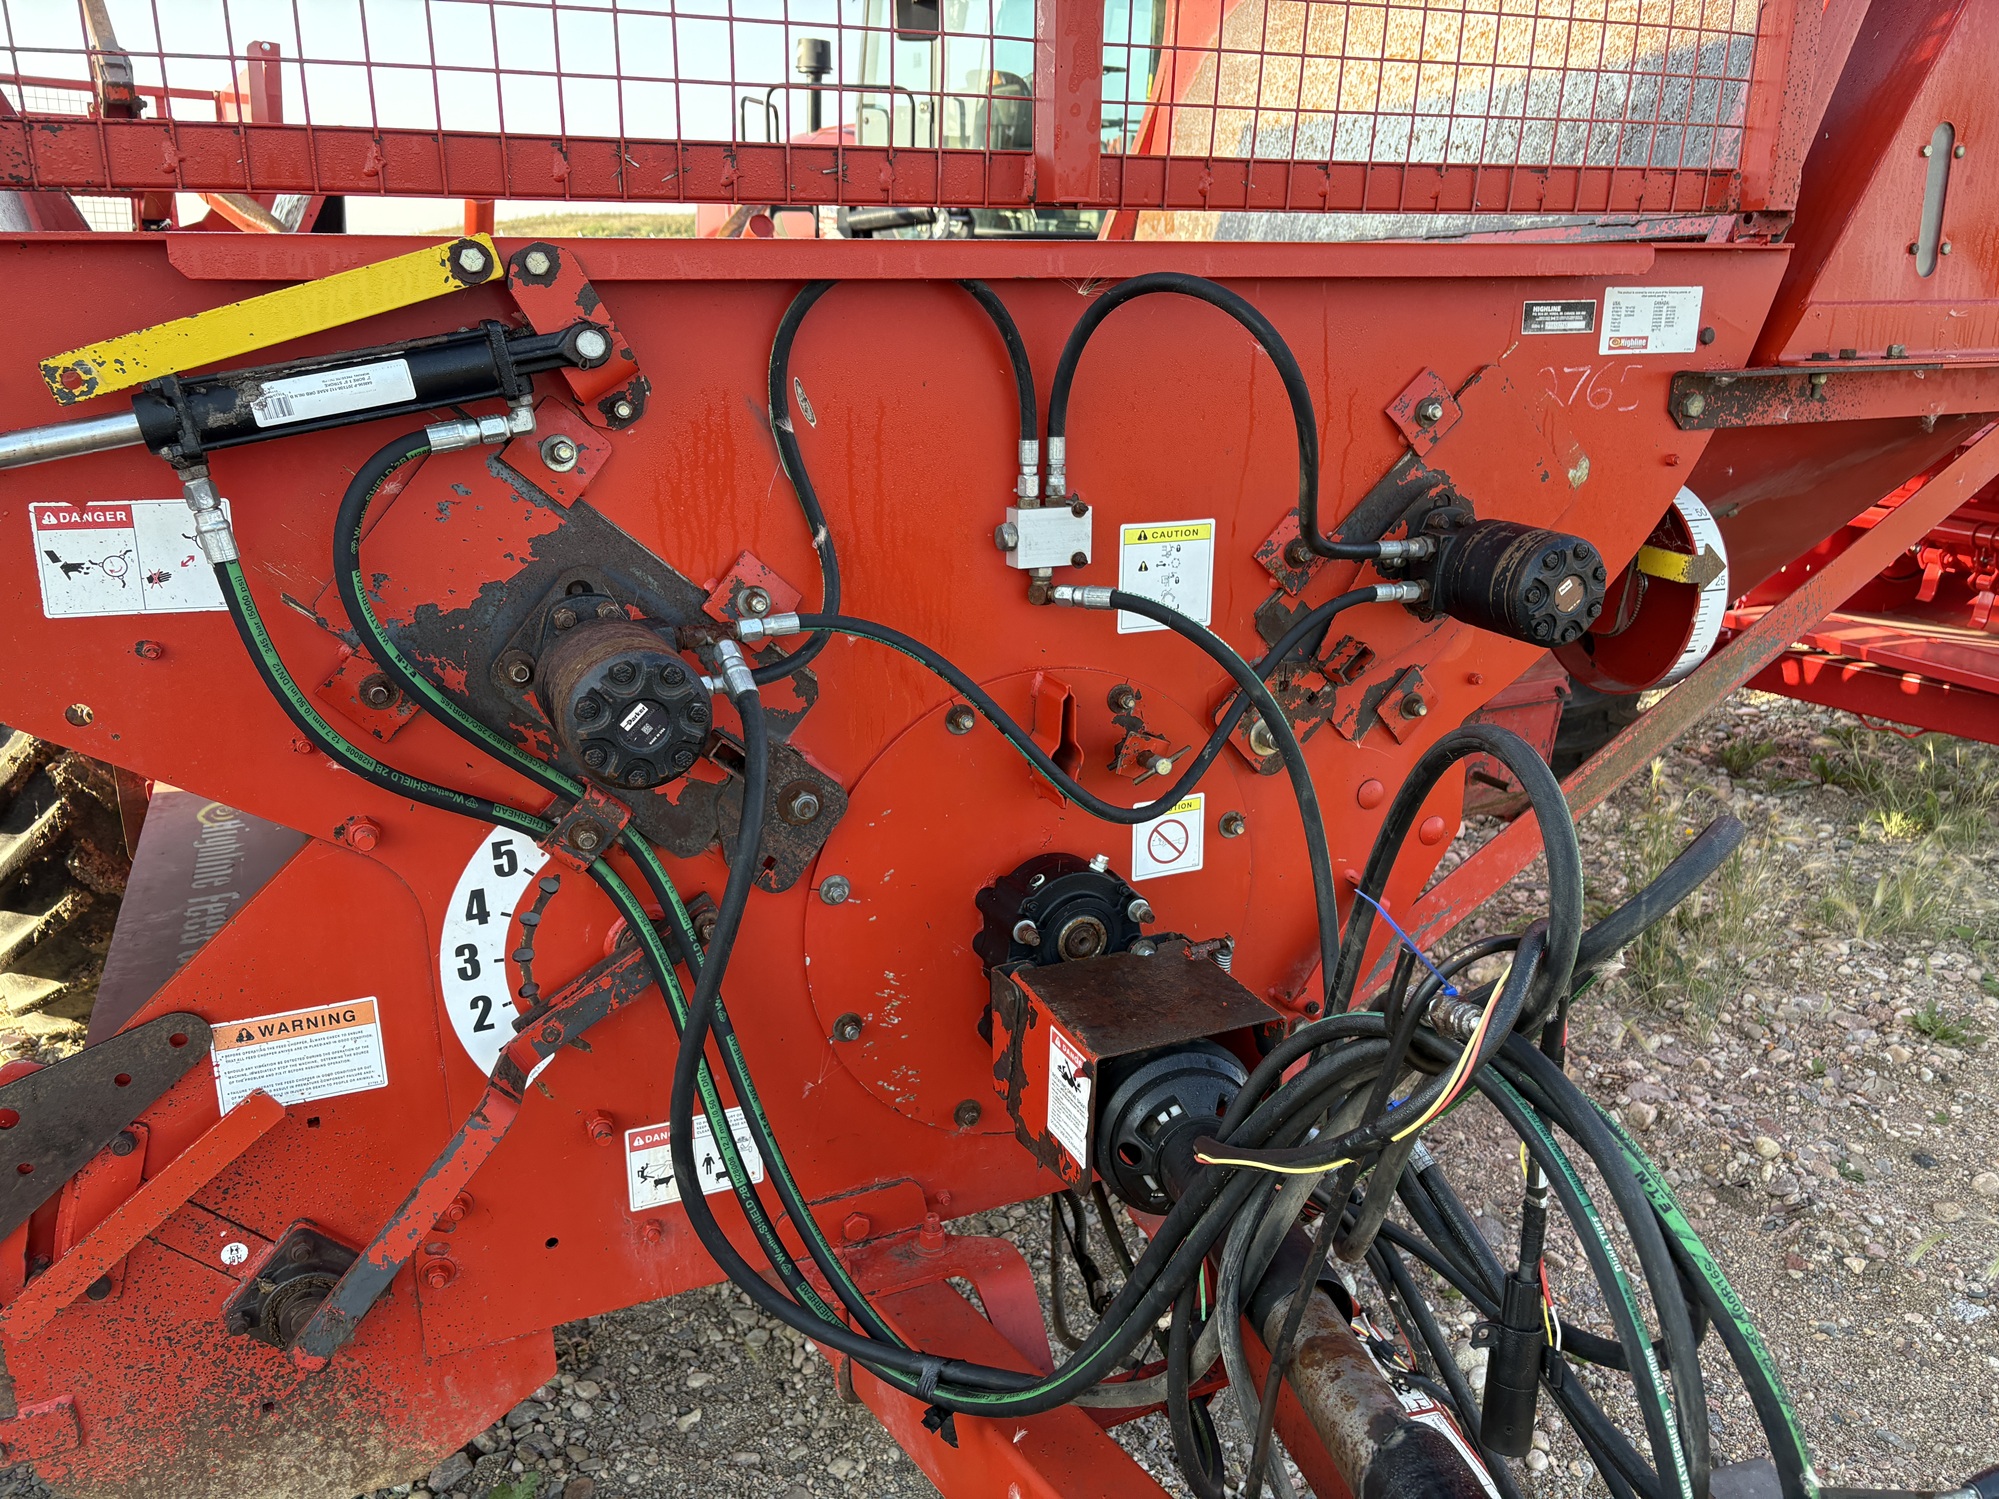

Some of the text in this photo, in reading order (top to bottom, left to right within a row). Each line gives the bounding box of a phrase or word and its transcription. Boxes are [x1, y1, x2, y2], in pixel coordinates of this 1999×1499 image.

[59, 511, 127, 523] DANGER
[1694, 508, 1708, 518] 50
[1151, 528, 1199, 540] CAUTION
[1715, 575, 1726, 586] 25
[355, 570, 390, 646] WEATHERHEAD
[234, 575, 552, 834] ATHERHEAD WeatherSHIELD 2B H28008 12.7 mm (0.50 in) DN12 345 bar (5000 psi)
[626, 705, 647, 727] Parker
[487, 733, 512, 751] EN857
[512, 748, 549, 773] EXCEEDS
[192, 819, 250, 889] Highline
[491, 839, 518, 878] 5
[465, 888, 491, 926] 4
[675, 898, 692, 927] H28008
[455, 943, 481, 981] 3
[258, 1010, 356, 1038] WARNING
[469, 995, 495, 1033] 2
[729, 1033, 759, 1103] WEATHERHEAD
[705, 1087, 715, 1100] in)
[709, 1100, 721, 1122] (0.50
[645, 1131, 671, 1144] DAN
[715, 1119, 726, 1135] mm
[719, 1136, 732, 1151] 12.7
[727, 1156, 745, 1184] H28008
[738, 1184, 751, 1199] 2B
[745, 1200, 785, 1265] WeatherSHIELD
[1664, 1408, 1694, 1499] WEATHERHEAD
